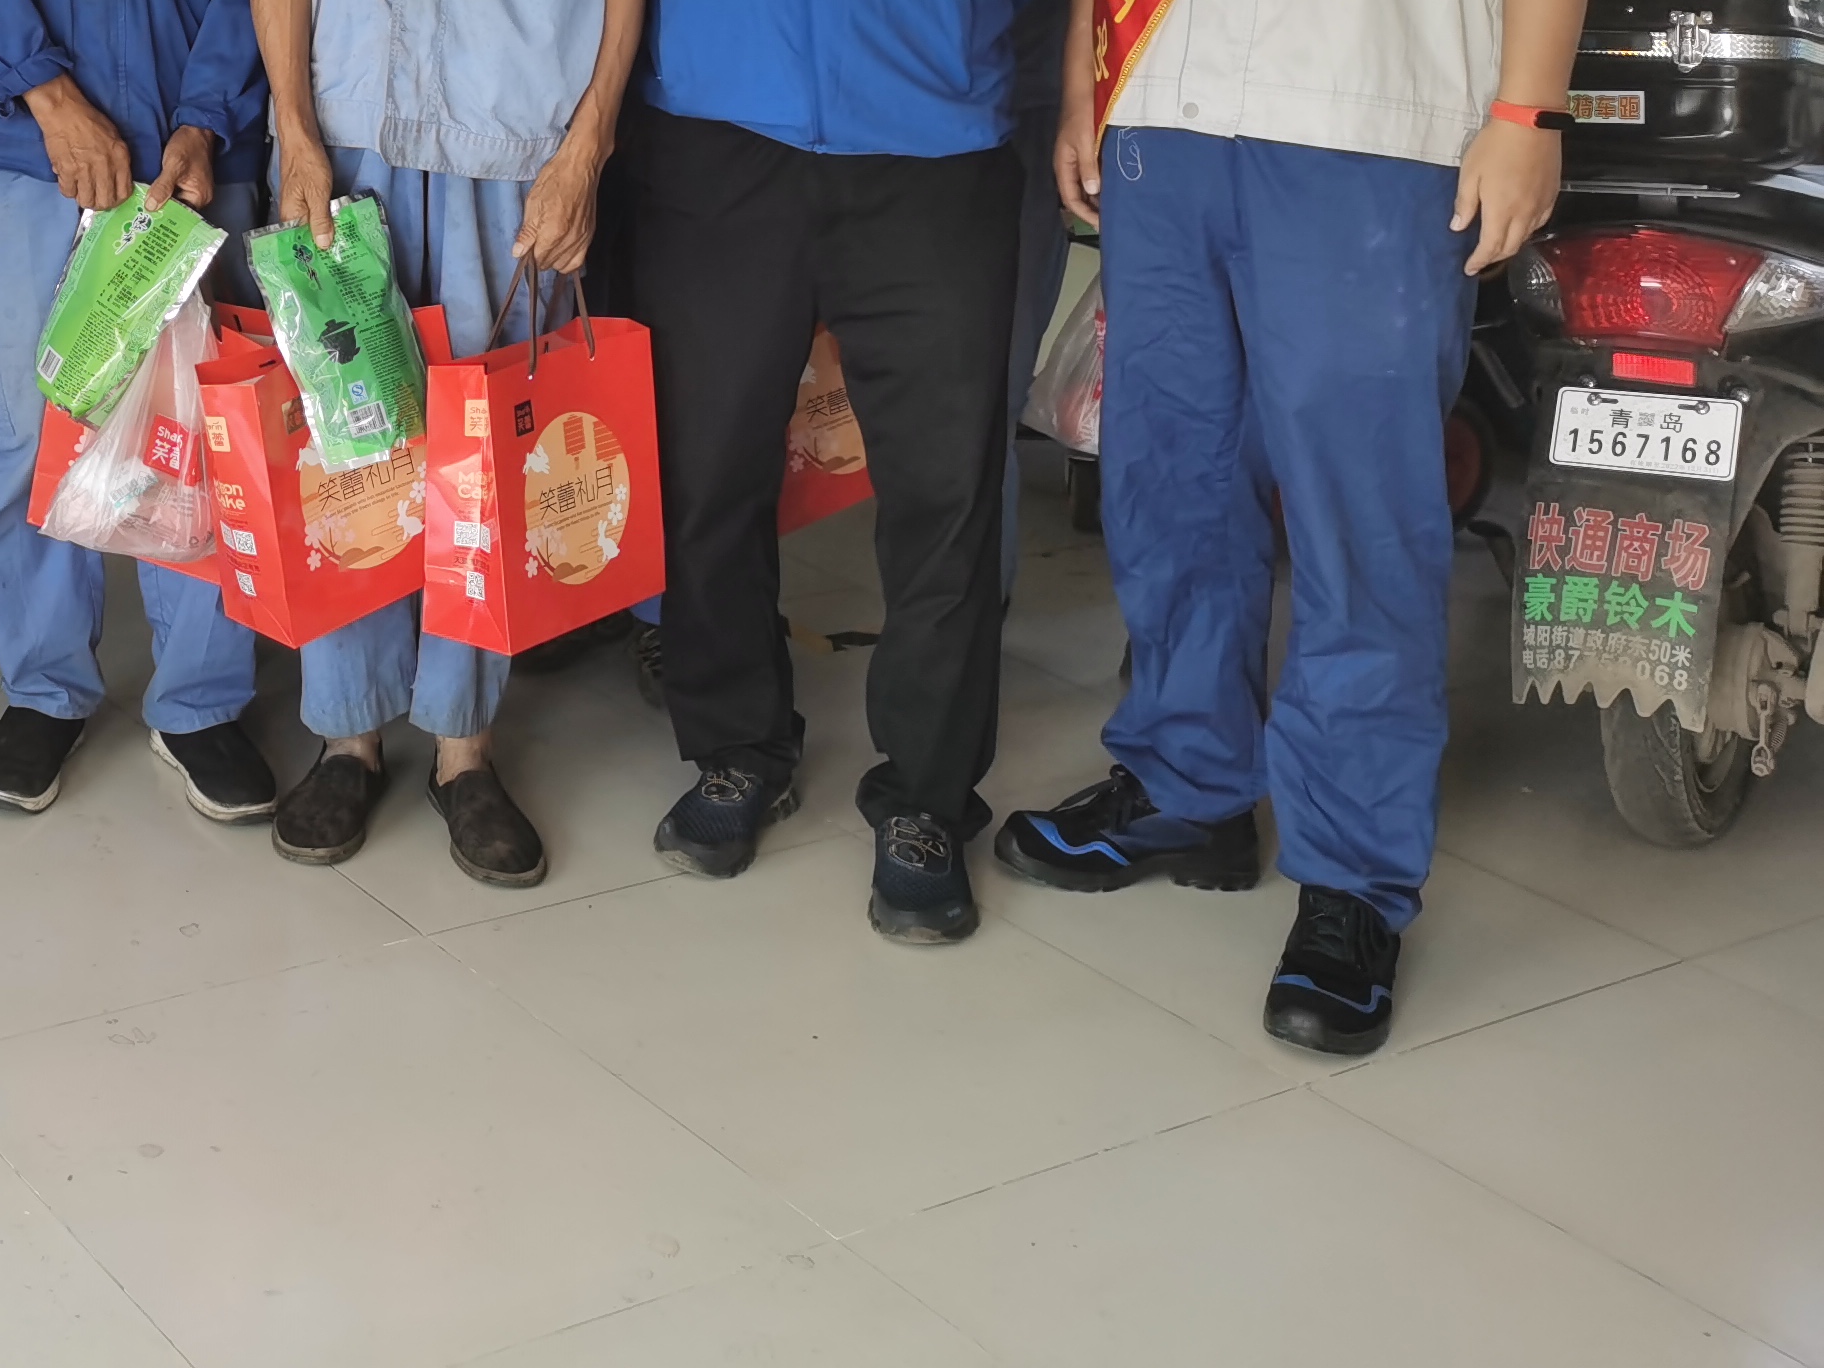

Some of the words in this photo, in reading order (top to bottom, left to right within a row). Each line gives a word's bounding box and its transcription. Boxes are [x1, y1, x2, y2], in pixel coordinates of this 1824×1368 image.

[1567, 94, 1640, 120] 持车距
[1568, 427, 1722, 466] 1567168
[317, 447, 414, 512] 笑蕾礼月
[539, 465, 614, 521] 笑蕾礼月
[1527, 501, 1711, 591] 快通商场
[1523, 573, 1698, 639] 豪爵铃木
[1522, 624, 1693, 668] 城阳街道政府东50米
